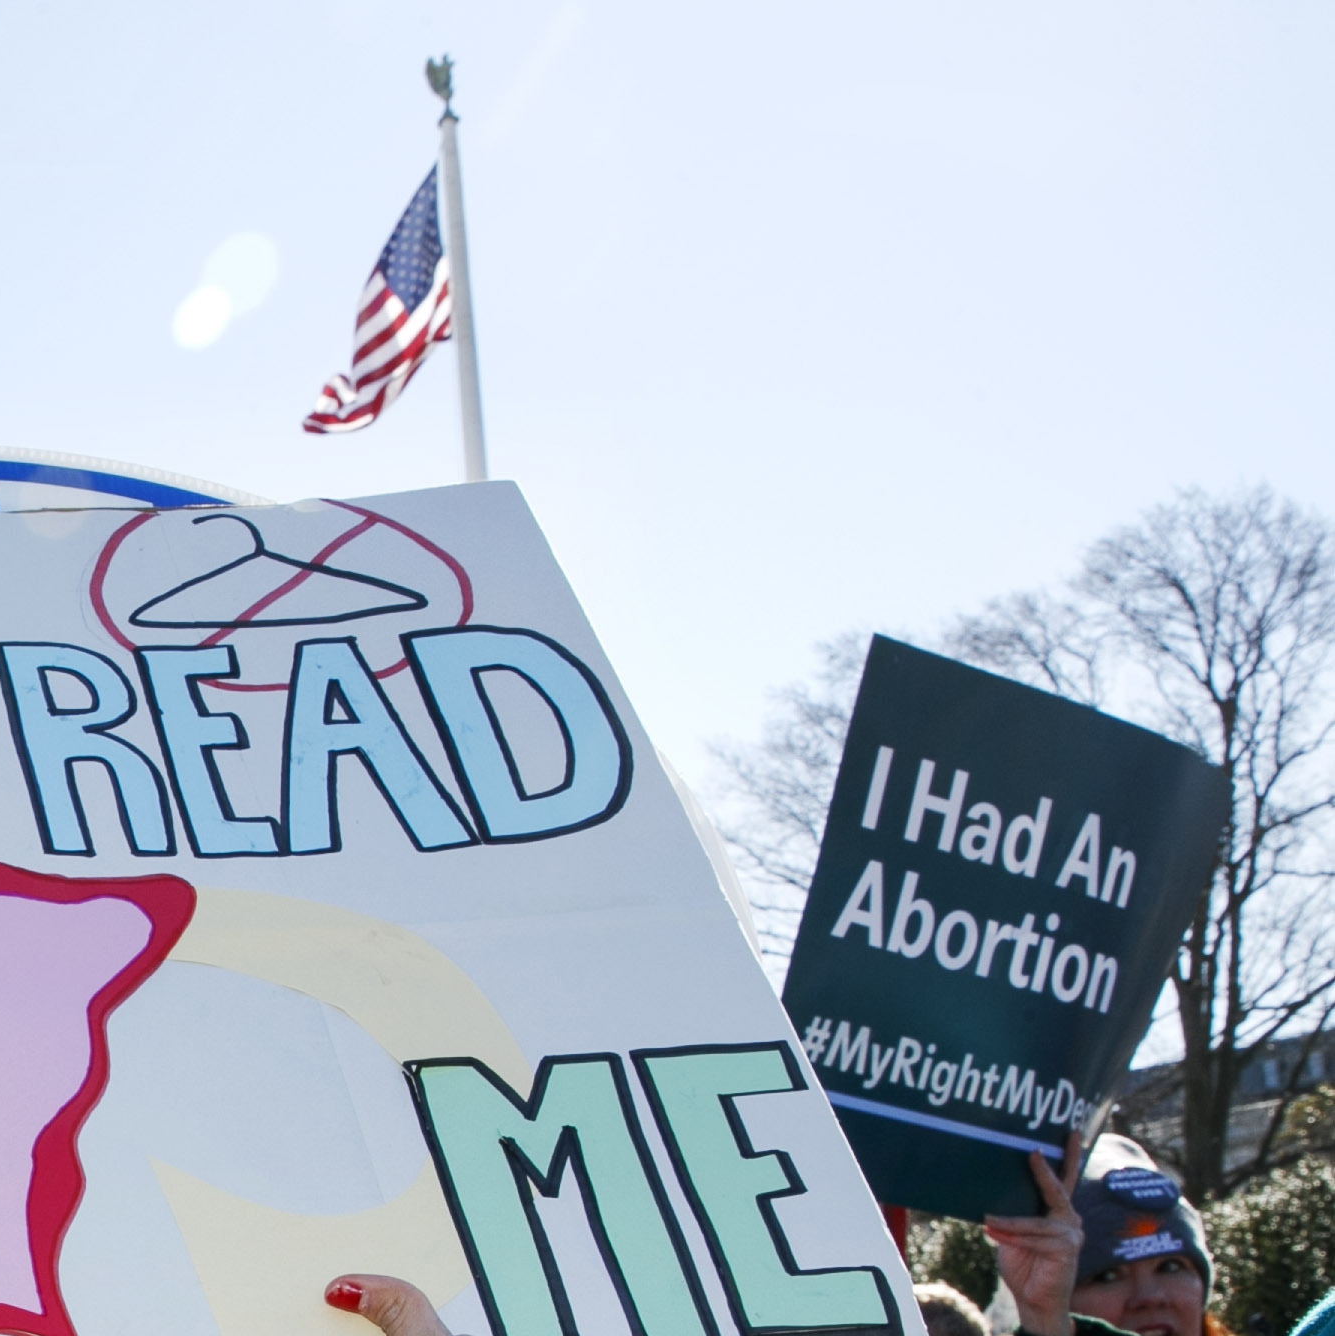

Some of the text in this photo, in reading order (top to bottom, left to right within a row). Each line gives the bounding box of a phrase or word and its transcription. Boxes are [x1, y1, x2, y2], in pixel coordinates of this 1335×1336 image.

[860, 745, 1138, 910] I Had An
[830, 858, 1120, 1015] Abortion
